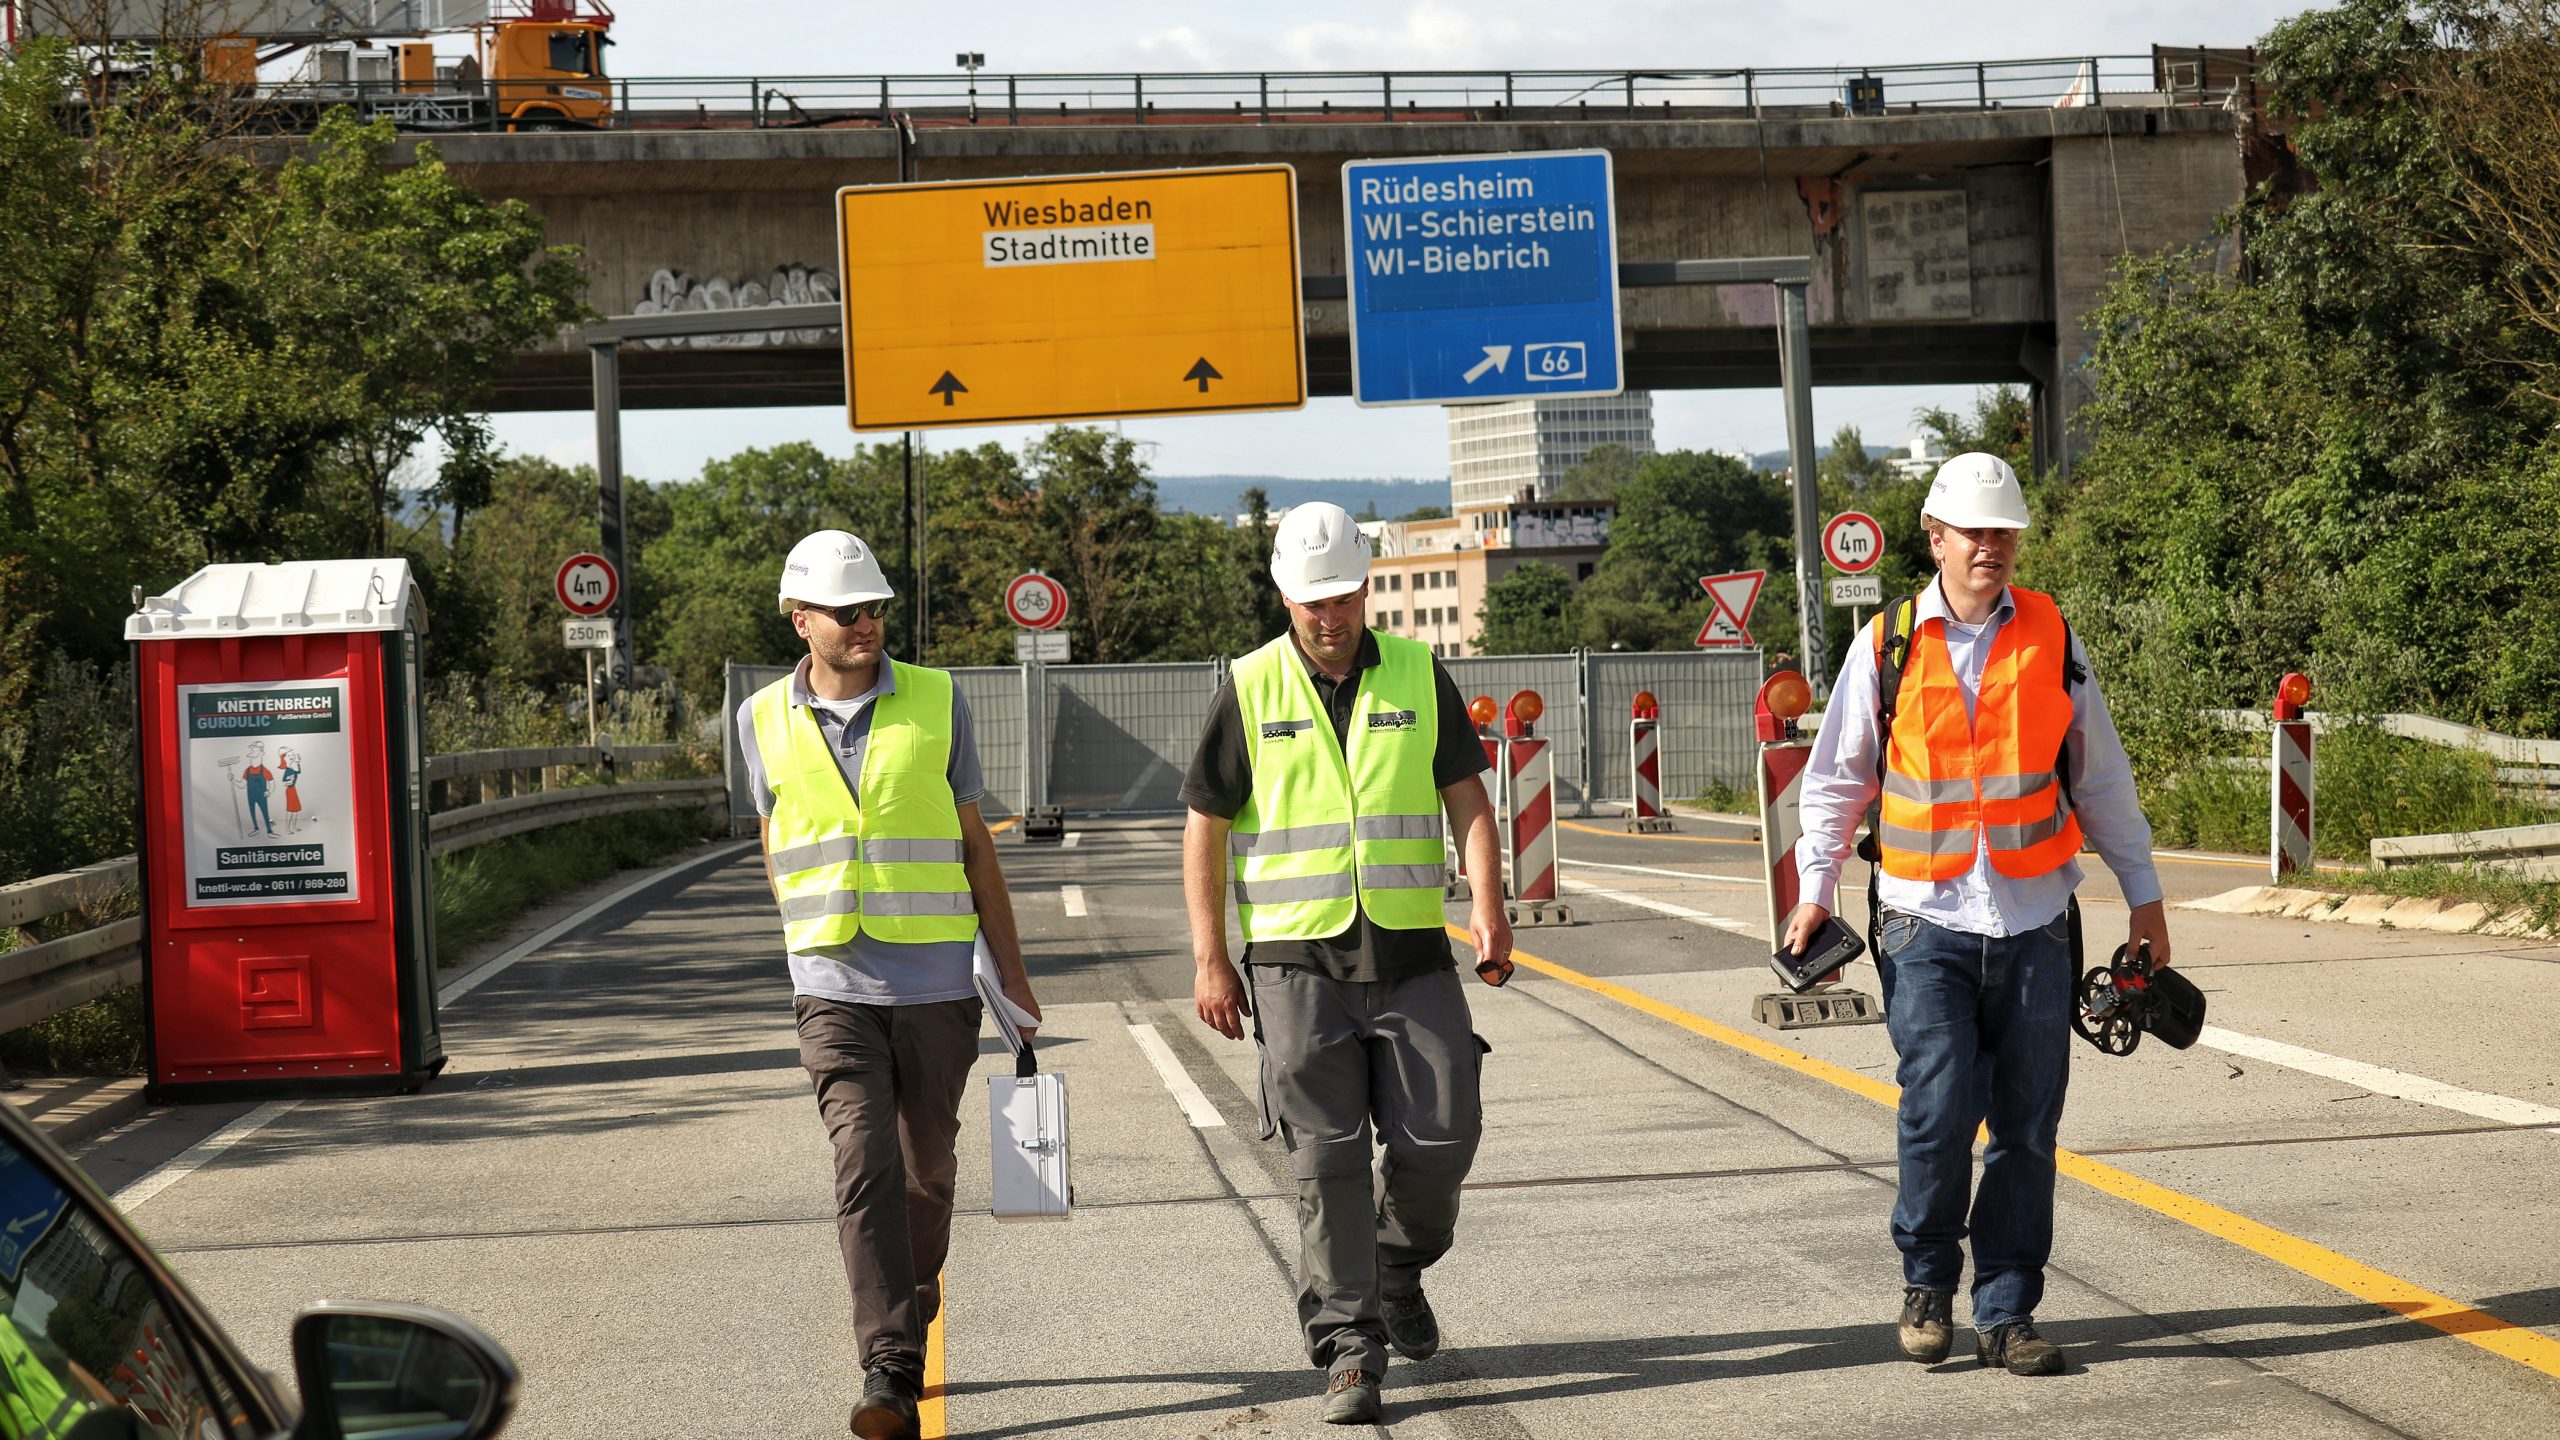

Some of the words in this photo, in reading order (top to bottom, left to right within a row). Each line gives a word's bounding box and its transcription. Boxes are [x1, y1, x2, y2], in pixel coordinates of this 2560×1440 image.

[1361, 172, 1534, 205] Rüdesheim
[983, 196, 1152, 227] Wiesbaden
[1364, 204, 1595, 241] WI-Schierstein
[990, 232, 1149, 262] Stadtmitte
[1366, 241, 1550, 276] WI-Biebrich
[1541, 350, 1570, 373] 66
[216, 696, 332, 714] KNETTENBRECH
[277, 712, 313, 721] FullService
[312, 711, 332, 719] GmbH
[196, 714, 271, 730] GURDULIC
[220, 848, 322, 865] Sanitärservice
[198, 880, 262, 894] knetti-wc.de
[271, 880, 295, 891] 0611
[304, 877, 346, 889] 969-280
